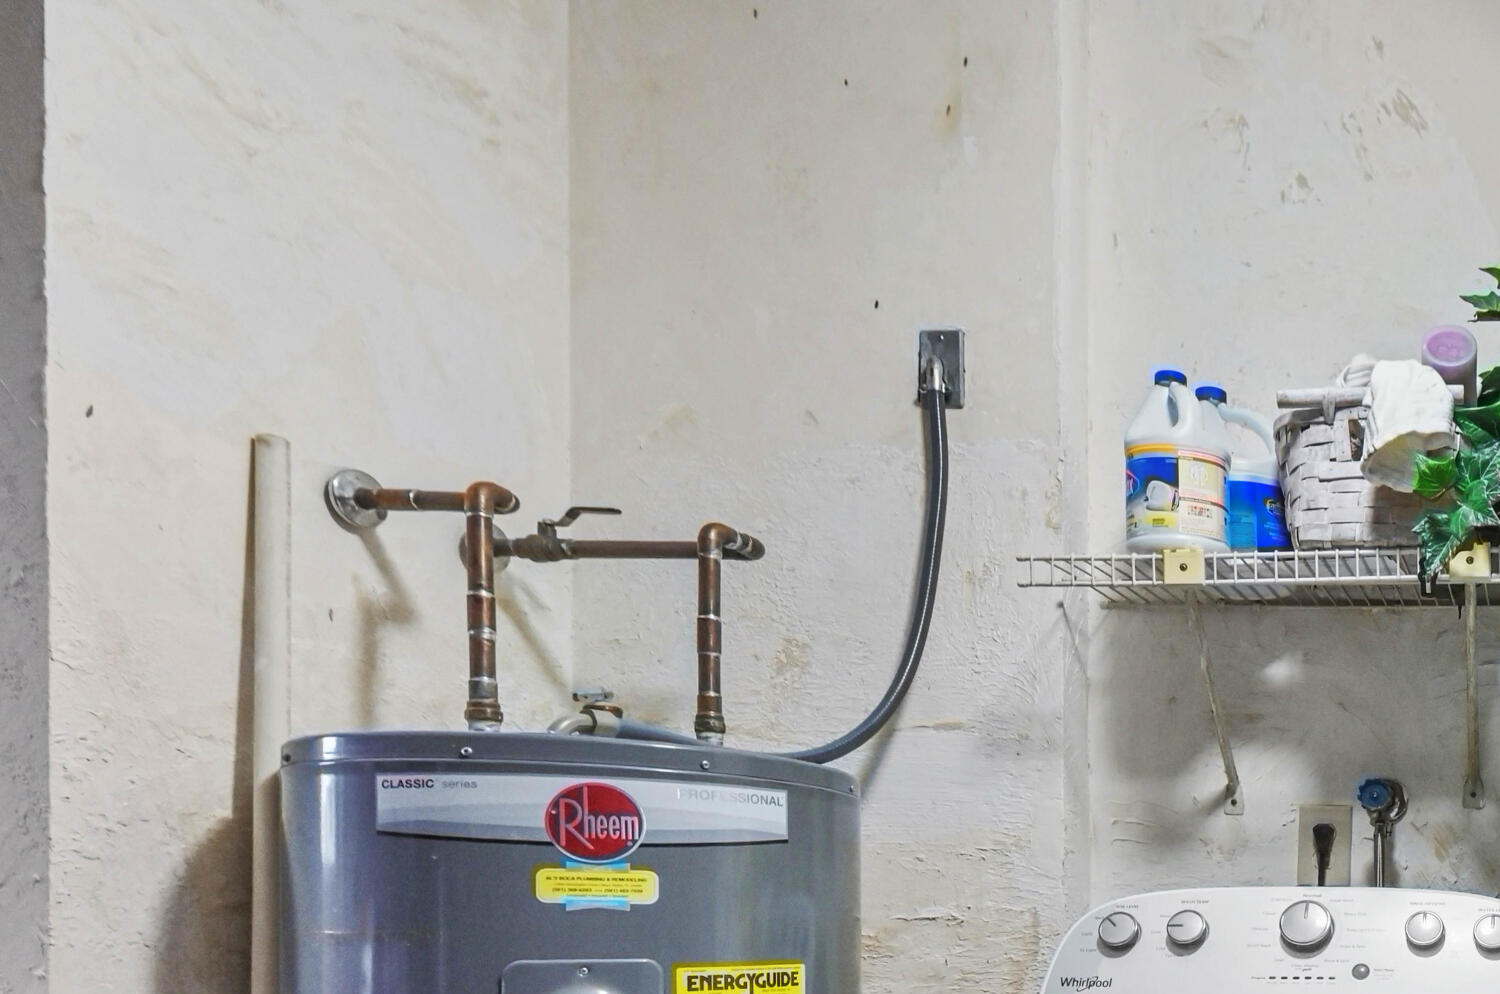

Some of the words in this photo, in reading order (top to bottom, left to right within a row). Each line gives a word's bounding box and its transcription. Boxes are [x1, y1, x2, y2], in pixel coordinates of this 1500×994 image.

[381, 779, 435, 789] CLASSIC
[441, 780, 478, 789] series
[677, 787, 783, 807] PROFESSIONAL
[559, 786, 639, 850] Rheem
[1060, 976, 1112, 992] Whirlpool
